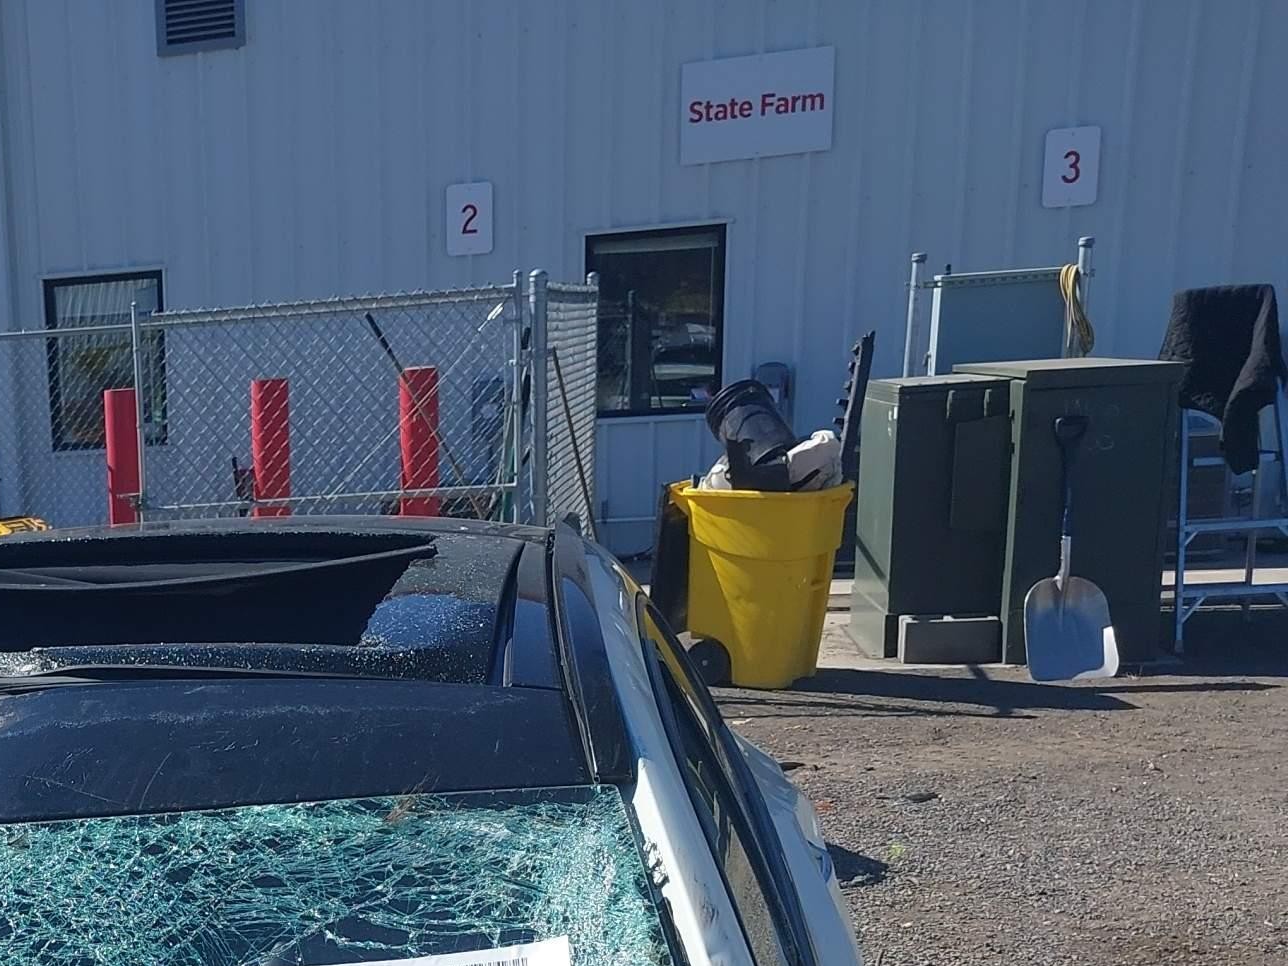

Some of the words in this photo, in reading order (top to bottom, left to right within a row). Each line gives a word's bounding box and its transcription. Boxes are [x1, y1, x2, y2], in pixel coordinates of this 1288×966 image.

[688, 97, 753, 124] State
[760, 92, 825, 117] Farm
[1061, 150, 1081, 184] 3
[461, 204, 478, 235] 2
